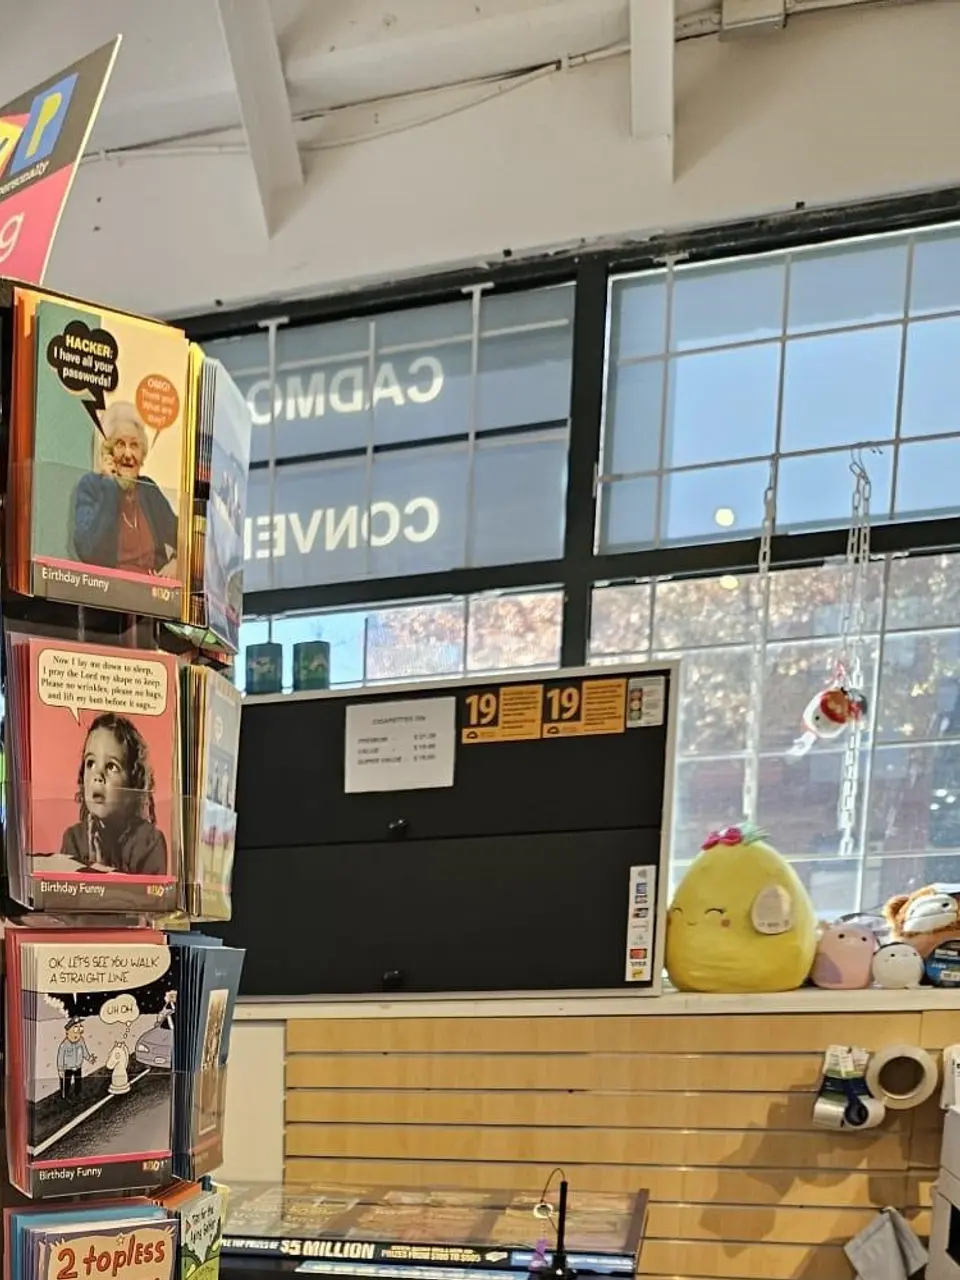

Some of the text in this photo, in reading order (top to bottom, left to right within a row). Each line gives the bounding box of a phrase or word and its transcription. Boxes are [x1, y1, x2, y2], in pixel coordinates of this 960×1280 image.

[65, 333, 113, 359] HACKER:
[59, 350, 114, 373] have all your
[62, 366, 112, 387] passwords!
[42, 566, 109, 592] Birthday Funny
[102, 661, 121, 670] down
[48, 667, 64, 676] pray
[81, 671, 98, 680] Lord
[113, 675, 132, 685] shape
[41, 679, 63, 688] Please
[111, 688, 133, 697] please
[105, 697, 126, 707] before
[465, 693, 497, 726] 19
[546, 687, 580, 721] 19
[40, 881, 105, 896] Birthday Funny
[92, 955, 159, 968] SEE YOU WALK
[59, 972, 105, 984] STRAIGHT
[108, 971, 130, 982] LINE
[106, 1005, 133, 1015] UH OH
[39, 1166, 102, 1182] Birthday Funny
[280, 1239, 302, 1257] $5
[303, 1240, 376, 1259] MILLION
[56, 1249, 79, 1280] 2
